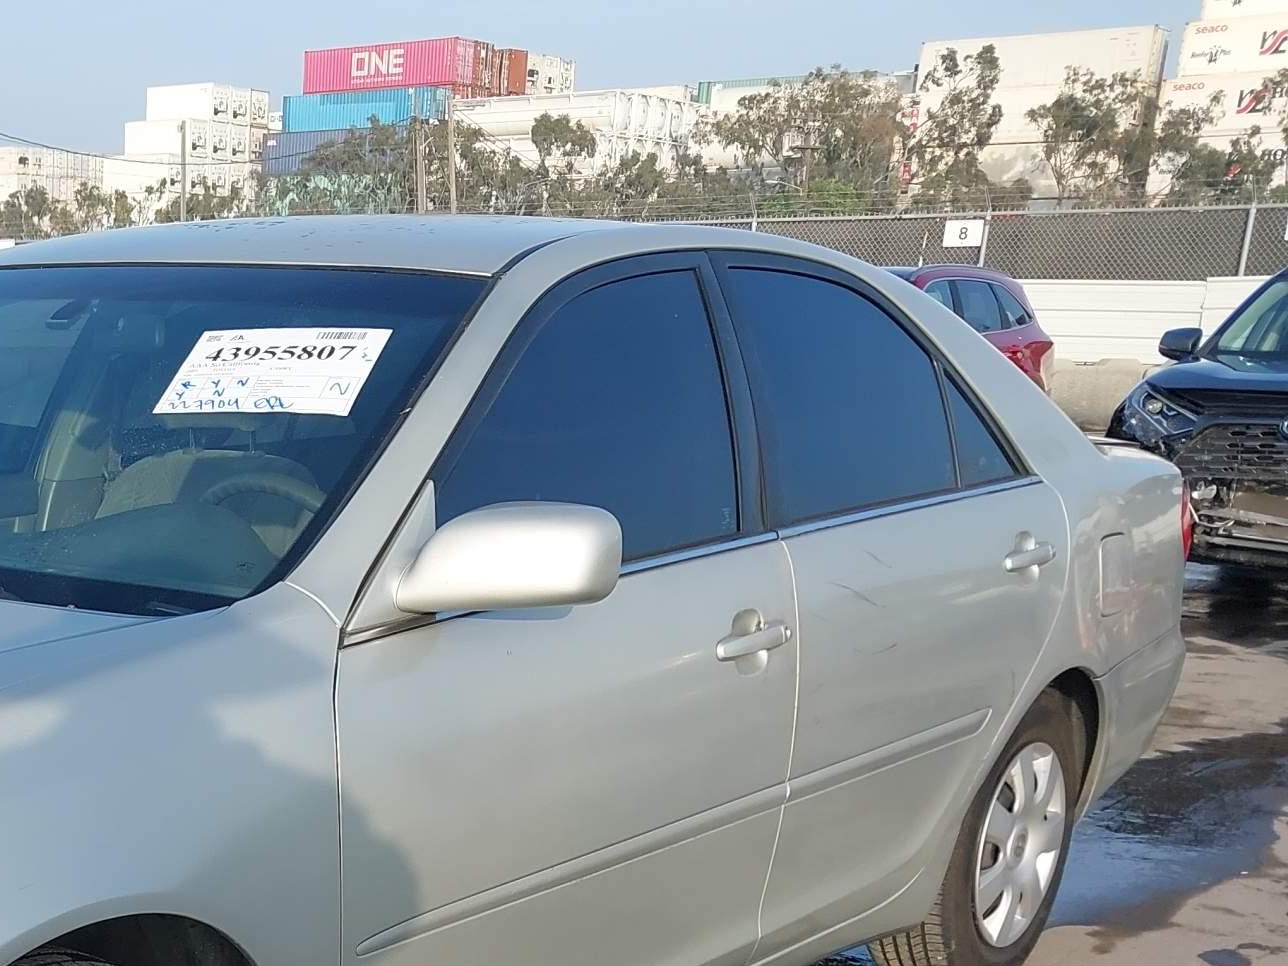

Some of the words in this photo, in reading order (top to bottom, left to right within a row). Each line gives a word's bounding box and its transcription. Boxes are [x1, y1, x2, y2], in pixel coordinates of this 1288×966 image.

[1195, 24, 1229, 35] seaco
[351, 48, 405, 78] ONE
[1172, 82, 1206, 92] seaco
[958, 226, 969, 241] 8
[205, 345, 357, 362] 43955807
